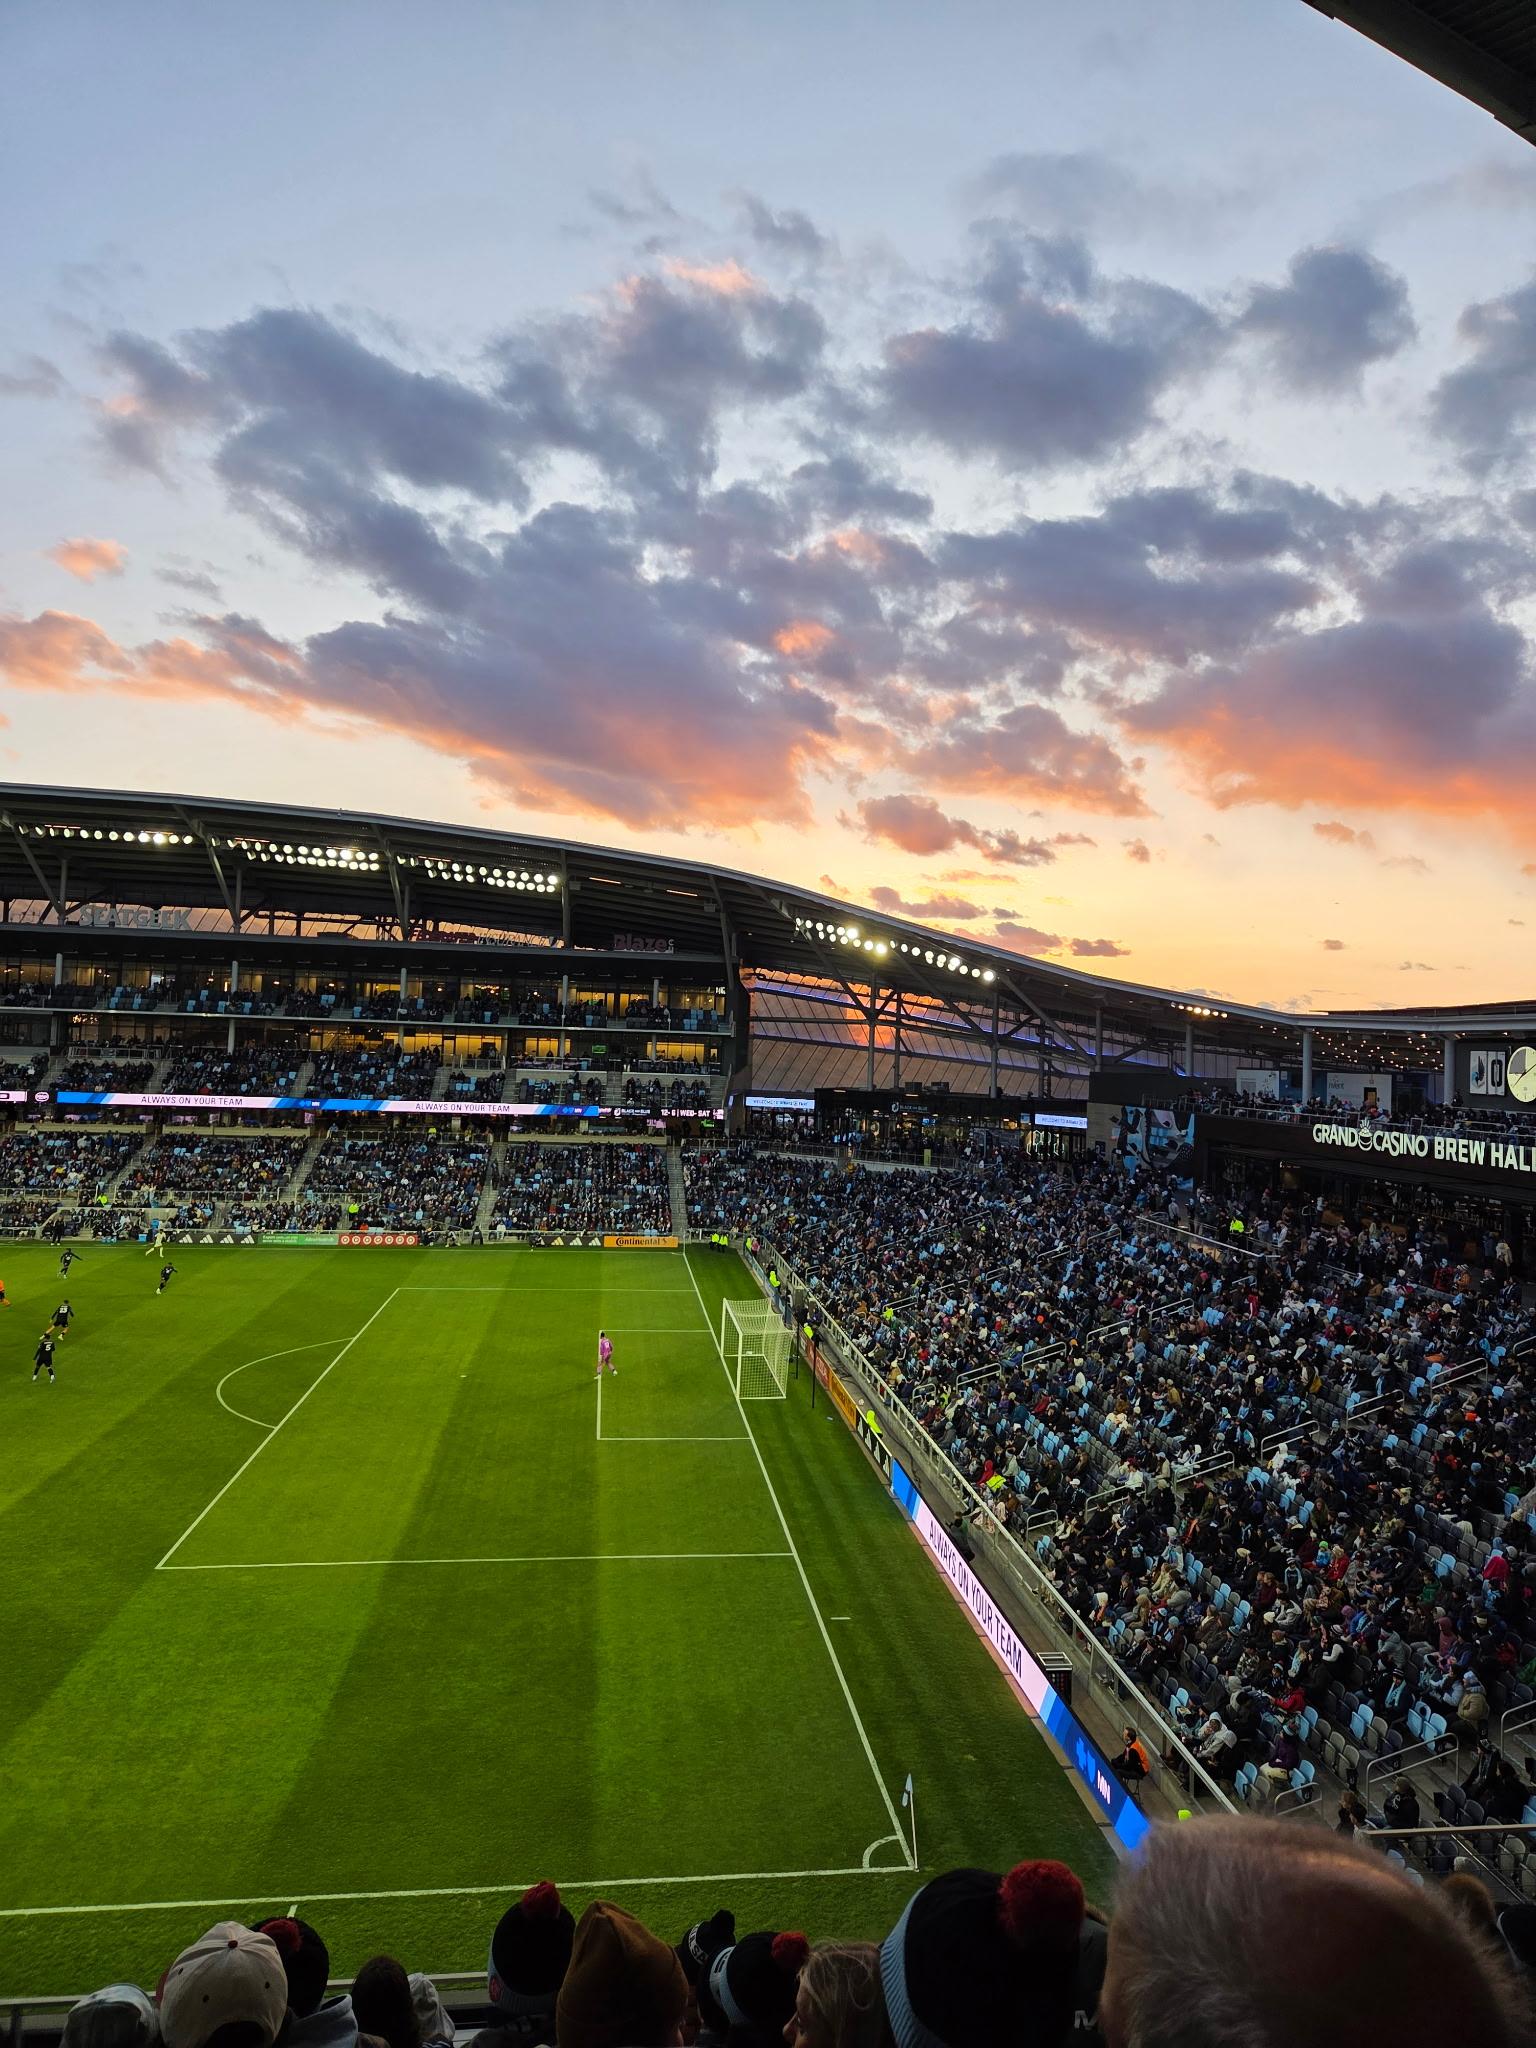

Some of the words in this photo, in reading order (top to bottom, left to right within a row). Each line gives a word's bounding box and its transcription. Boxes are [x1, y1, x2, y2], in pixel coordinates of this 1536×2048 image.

[79, 902, 192, 930] SEATGEEK
[614, 933, 667, 952] Blaze
[141, 1095, 177, 1105] ALWAYS
[179, 1096, 191, 1105] ON
[193, 1096, 217, 1106] YOUR
[218, 1097, 243, 1106] TEAM
[415, 1103, 448, 1111] ALWAYS
[450, 1103, 462, 1112] ON
[463, 1104, 486, 1112] YOUR
[488, 1104, 511, 1113] TEAM
[1312, 1123, 1358, 1148] GRAND
[1373, 1130, 1429, 1157] CASINO
[1434, 1136, 1486, 1166] BREW
[615, 1237, 662, 1247] Continental
[928, 1520, 957, 1579] ALWAYS
[958, 1561, 970, 1599] ON
[971, 1579, 994, 1635] YOUR
[995, 1612, 1022, 1679] TEAM
